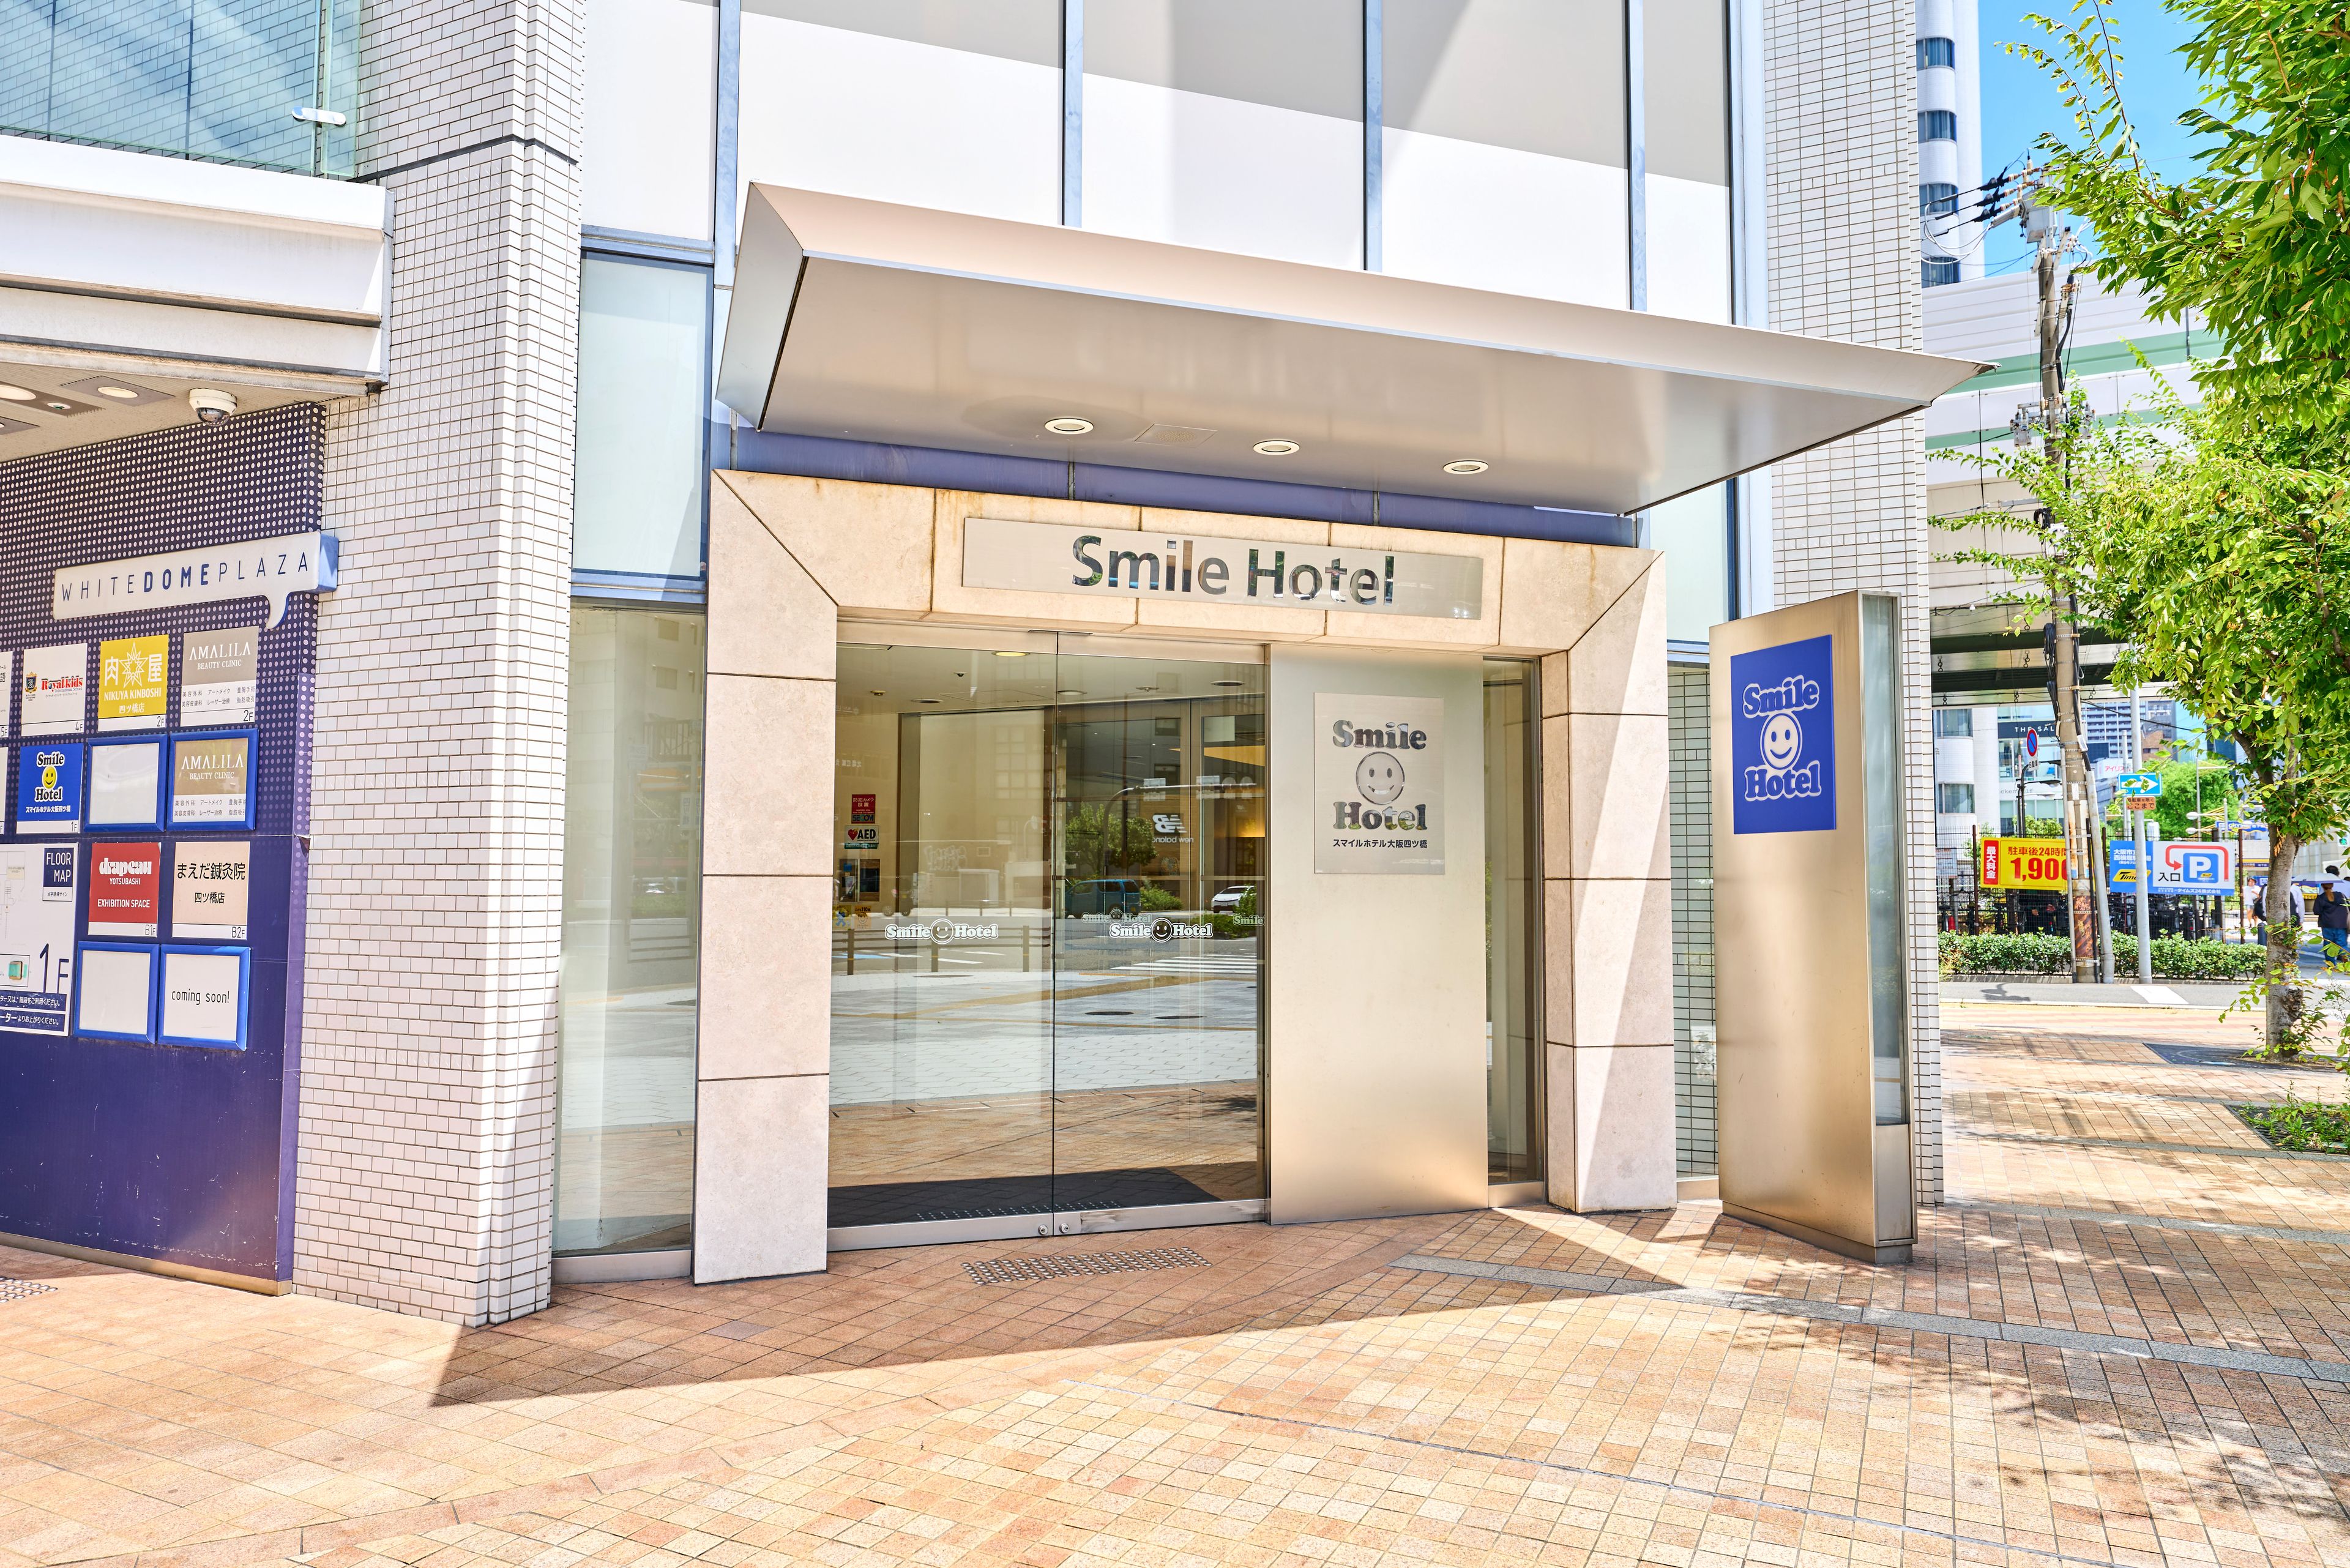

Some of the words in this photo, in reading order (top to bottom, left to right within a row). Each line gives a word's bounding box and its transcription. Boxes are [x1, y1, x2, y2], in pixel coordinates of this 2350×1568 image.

[1071, 534, 1230, 595] Smile
[1247, 548, 1395, 606] Hotel
[188, 641, 252, 660] AMALILA
[105, 656, 119, 686] 肉
[147, 654, 162, 682] 屋
[197, 661, 221, 670] BEAUTY
[222, 659, 242, 668] CLINIC
[104, 690, 129, 701] NIKUYA
[130, 687, 162, 699] KINBOSHI
[1744, 676, 1819, 717] Smile
[119, 703, 144, 714] 四ツ橋店
[157, 716, 165, 727] 2F
[244, 709, 253, 722] 2F
[1, 726, 7, 737] 5F
[75, 722, 83, 732] 4F
[1333, 719, 1427, 750] Smile
[37, 752, 64, 766] Smile
[181, 753, 244, 769] AMALILA
[1745, 763, 1821, 799] Hotel
[35, 788, 62, 801] Hotel
[25, 805, 71, 813] スマイルホテル大阪四ツ橋
[1333, 801, 1428, 830] Hotel
[71, 821, 77, 832] 1F
[857, 829, 876, 839] AED
[1333, 838, 1428, 848] スマイルホテル大阪四ツ橋
[46, 852, 71, 865] FLOOR
[1986, 846, 1996, 879] 最大料金
[177, 862, 245, 880] まえだ鍼灸院
[2189, 856, 2212, 879] P
[53, 869, 71, 882] MAP
[2158, 872, 2180, 882] 入口
[97, 898, 130, 908] EXHIBITION
[131, 899, 151, 908] SPACE
[194, 892, 225, 904] 四ツ橋店
[1082, 912, 1109, 923] Smile
[1233, 914, 1264, 925] Smile
[145, 925, 155, 936] B1F
[231, 926, 245, 938] B2F
[886, 924, 931, 939] Smile
[954, 924, 998, 938] Hotel
[1110, 924, 1151, 938] Smile
[1172, 923, 1213, 938] Hotel
[39, 943, 70, 993] 1F
[171, 988, 201, 1006] coming
[206, 990, 229, 1004] soon!
